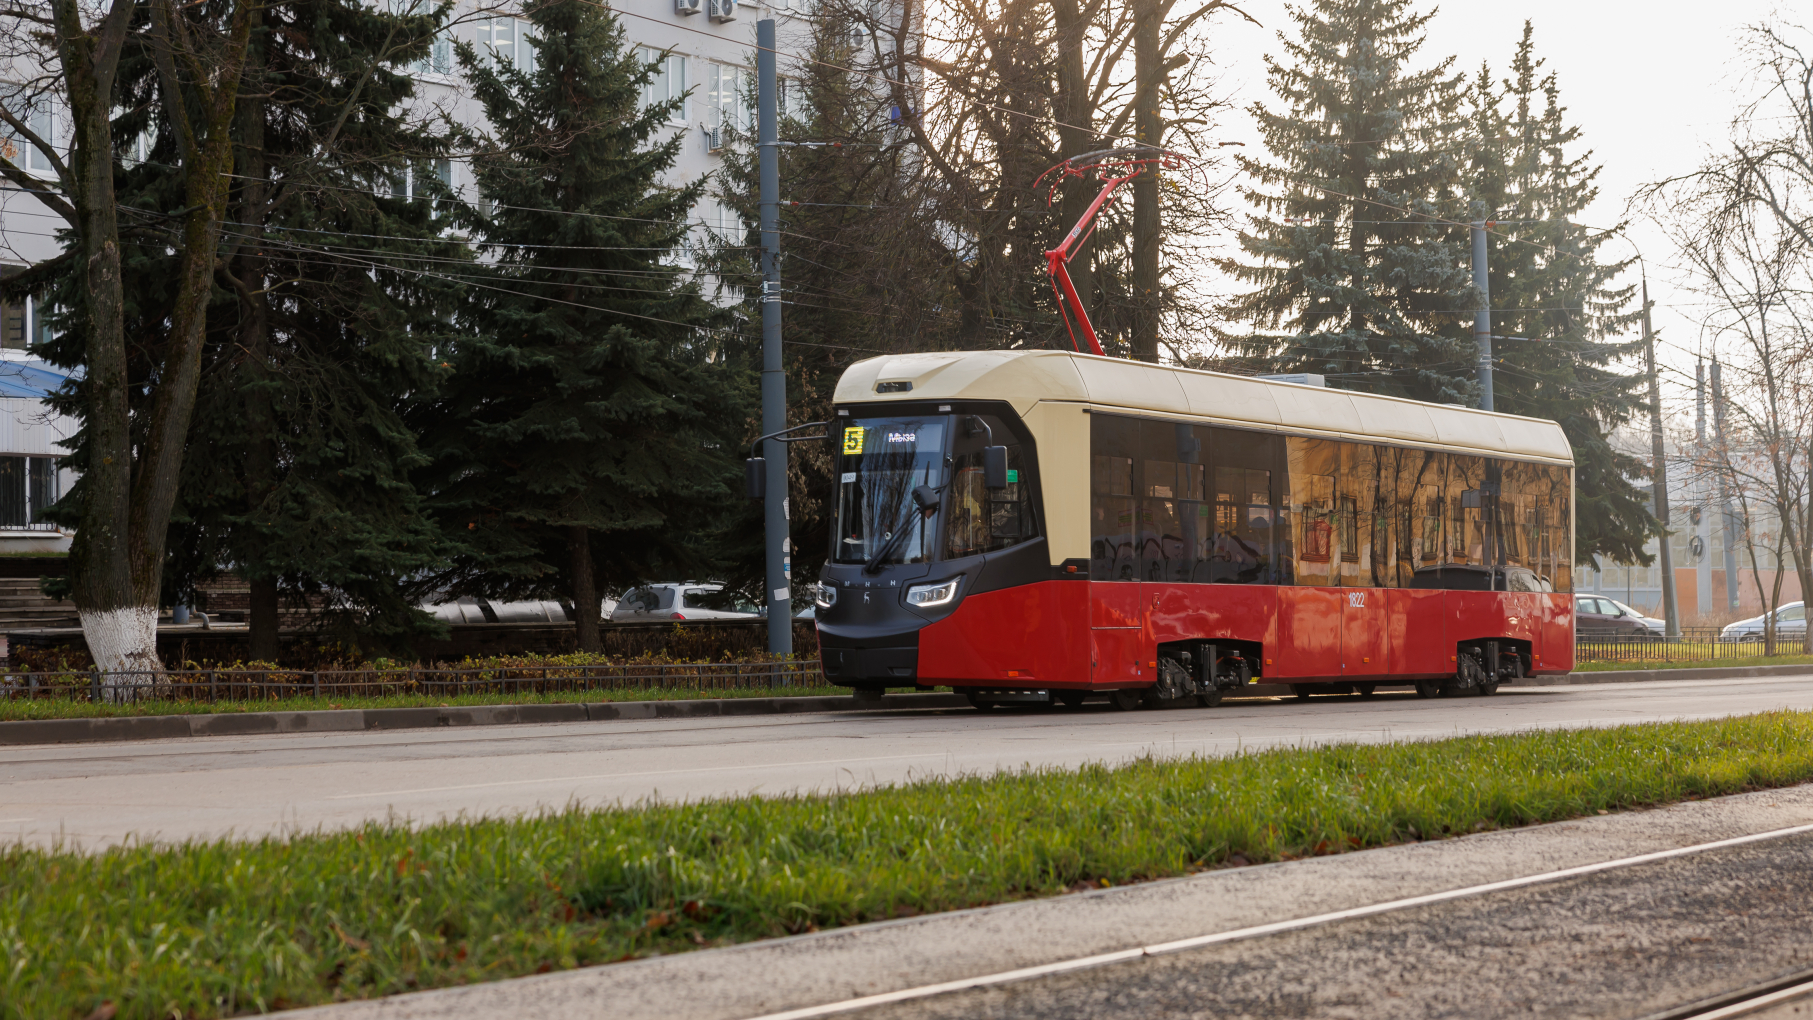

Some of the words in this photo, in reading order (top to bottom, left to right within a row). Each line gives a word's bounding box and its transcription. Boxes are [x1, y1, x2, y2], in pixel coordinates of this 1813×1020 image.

[846, 430, 859, 451] 5
[888, 432, 915, 442] Мыза
[1349, 592, 1364, 607] 1822
